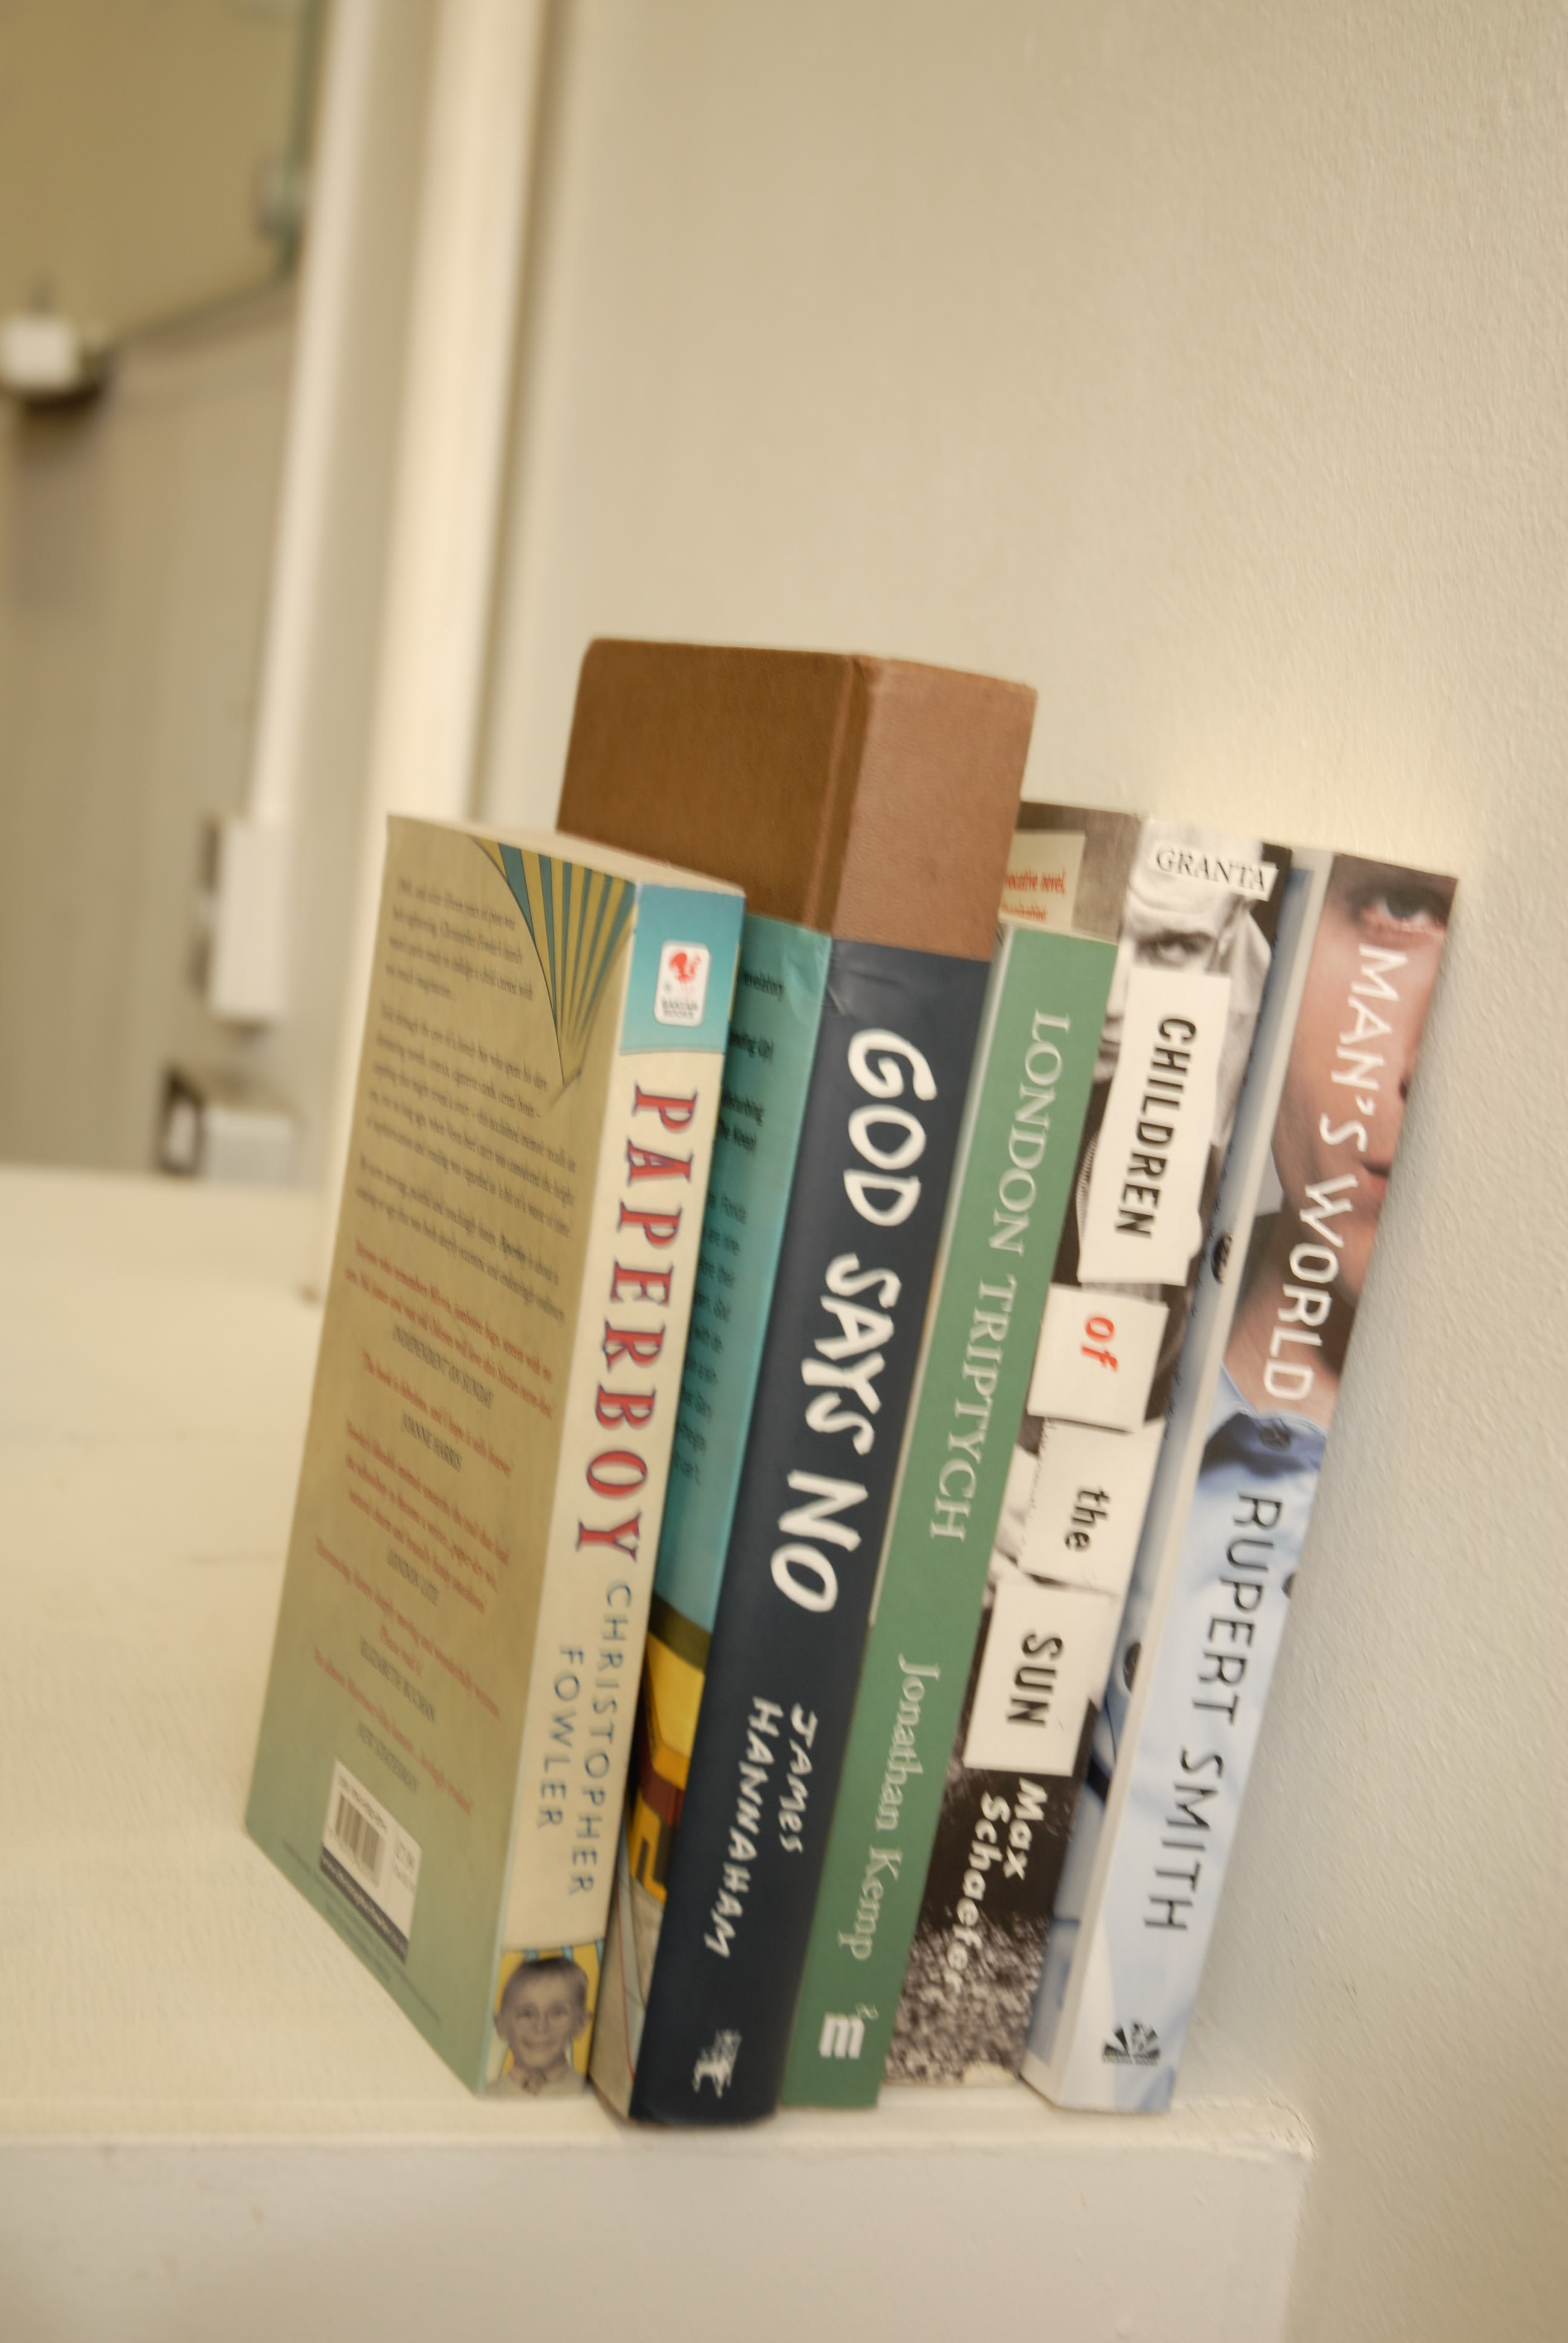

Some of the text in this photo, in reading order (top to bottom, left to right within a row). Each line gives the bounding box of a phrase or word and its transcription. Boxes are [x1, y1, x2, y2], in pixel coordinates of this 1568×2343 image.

[1156, 847, 1265, 893] GRANTA
[988, 1009, 1071, 1256] LONDON
[1114, 1017, 1197, 1239] CHILDREN
[1263, 943, 1408, 1401] MAN'S WORLD
[576, 1085, 699, 1562] PAPERBOY
[770, 1028, 937, 1613] GOD SAYS NO
[930, 1274, 1017, 1541] TRIPTYCH
[1080, 1316, 1119, 1374] of
[1064, 1486, 1111, 1552] the
[537, 1645, 584, 1829] FOWLER
[569, 1581, 633, 1895] CHRISTOPHER
[838, 1653, 941, 1961] Jonathan Kemp
[1006, 1631, 1064, 1729] SUN
[1143, 1491, 1284, 1931] RUPERT SMITH
[704, 1696, 783, 1958] HANNAHAM
[1002, 1777, 1048, 1880] Max
